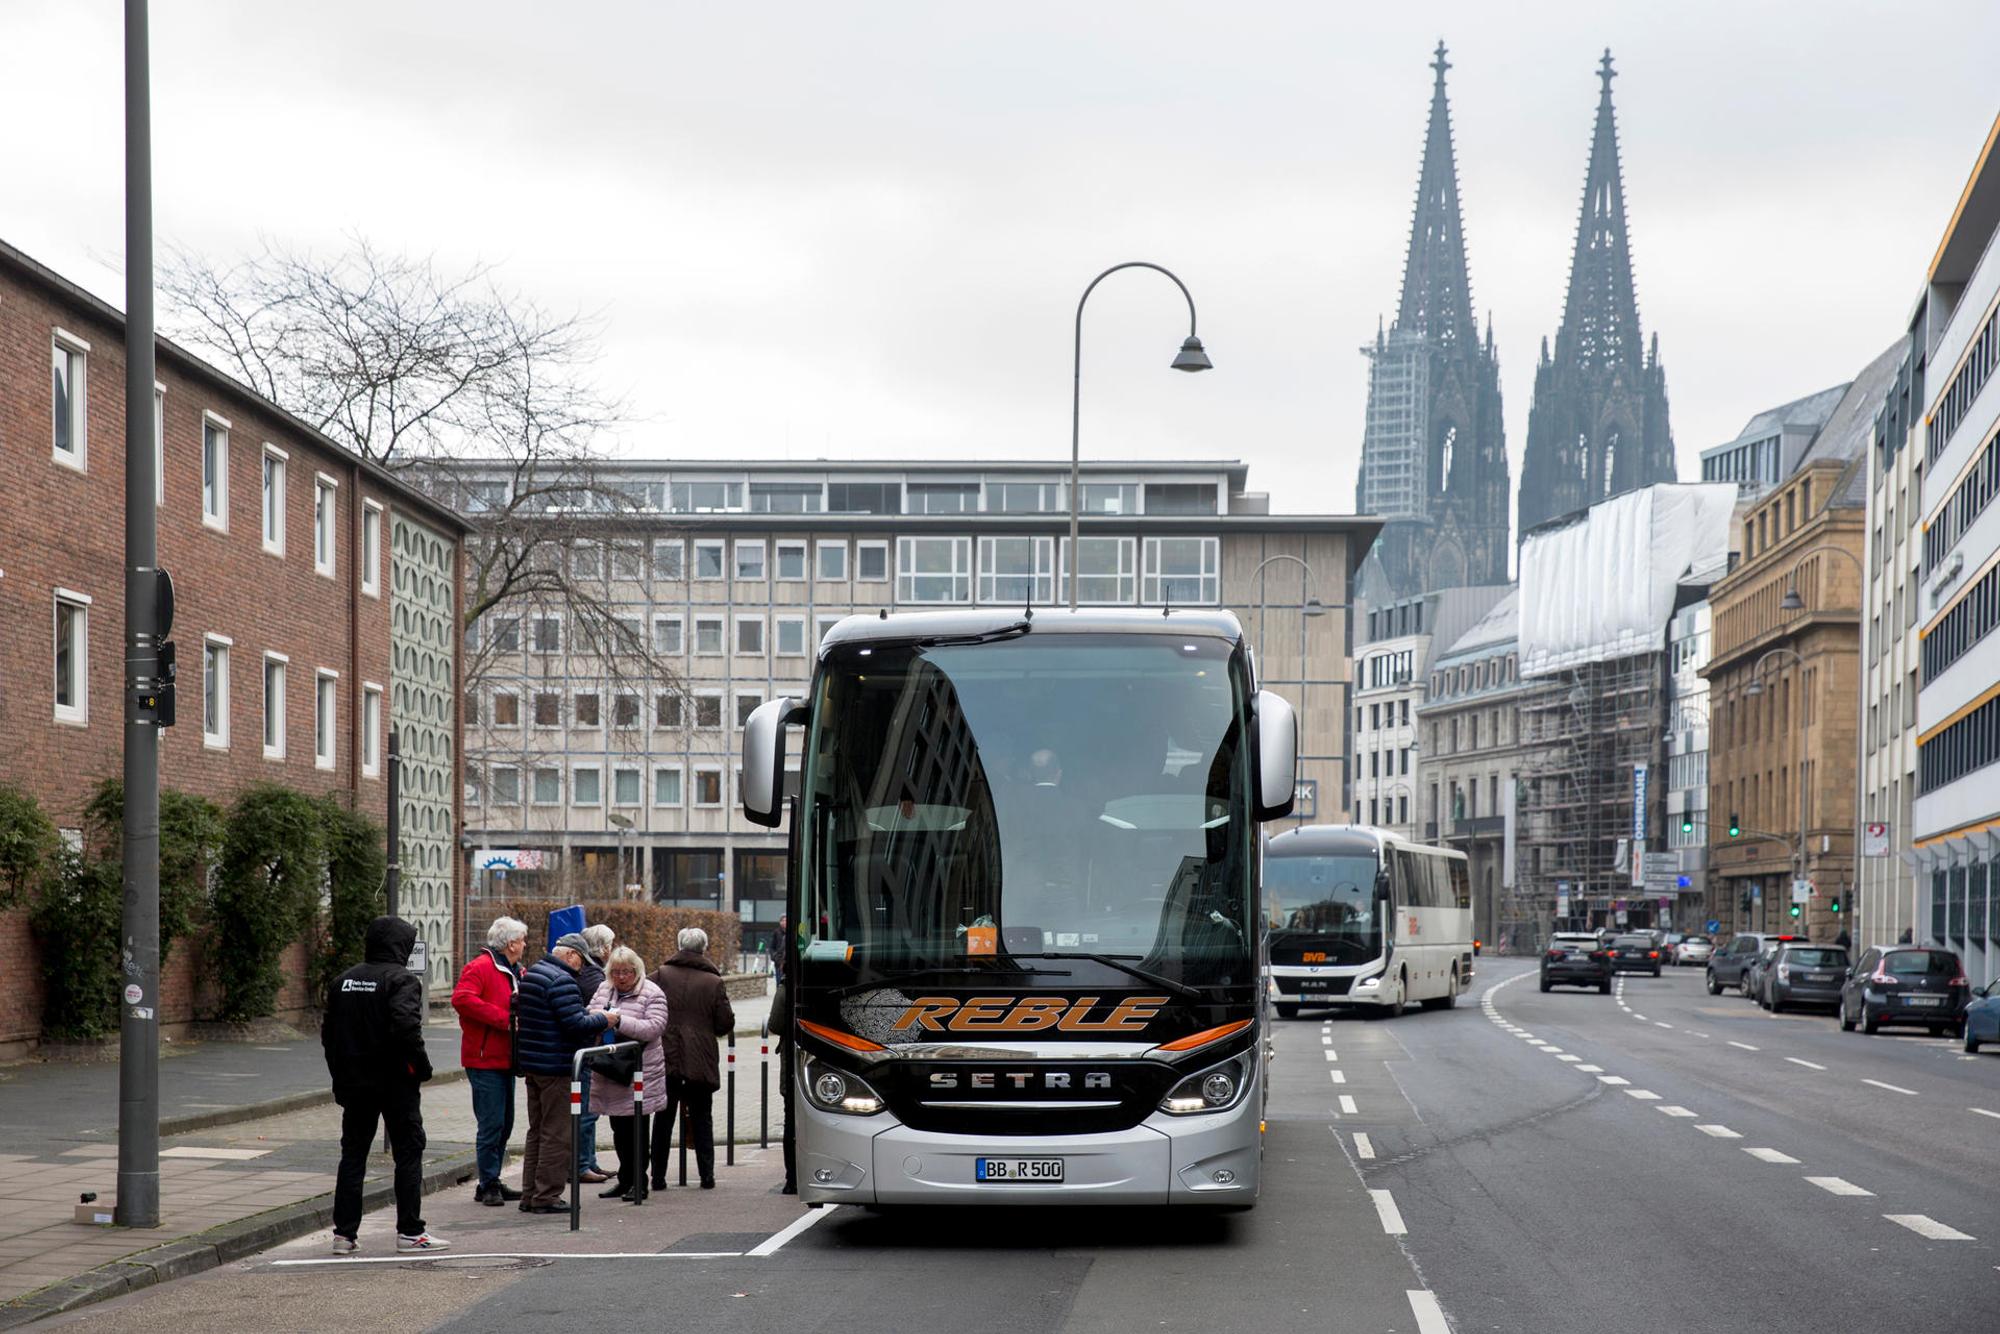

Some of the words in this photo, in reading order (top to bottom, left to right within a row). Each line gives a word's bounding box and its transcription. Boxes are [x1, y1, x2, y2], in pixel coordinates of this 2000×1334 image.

[1294, 786, 1313, 799] HK
[1635, 770, 1645, 840] ODENDAHL
[891, 997, 1171, 1031] REBLE
[930, 1072, 1112, 1088] SETRA
[987, 1162, 1007, 1177] BB
[1018, 1162, 1028, 1177] R
[1031, 1162, 1061, 1177] 500
